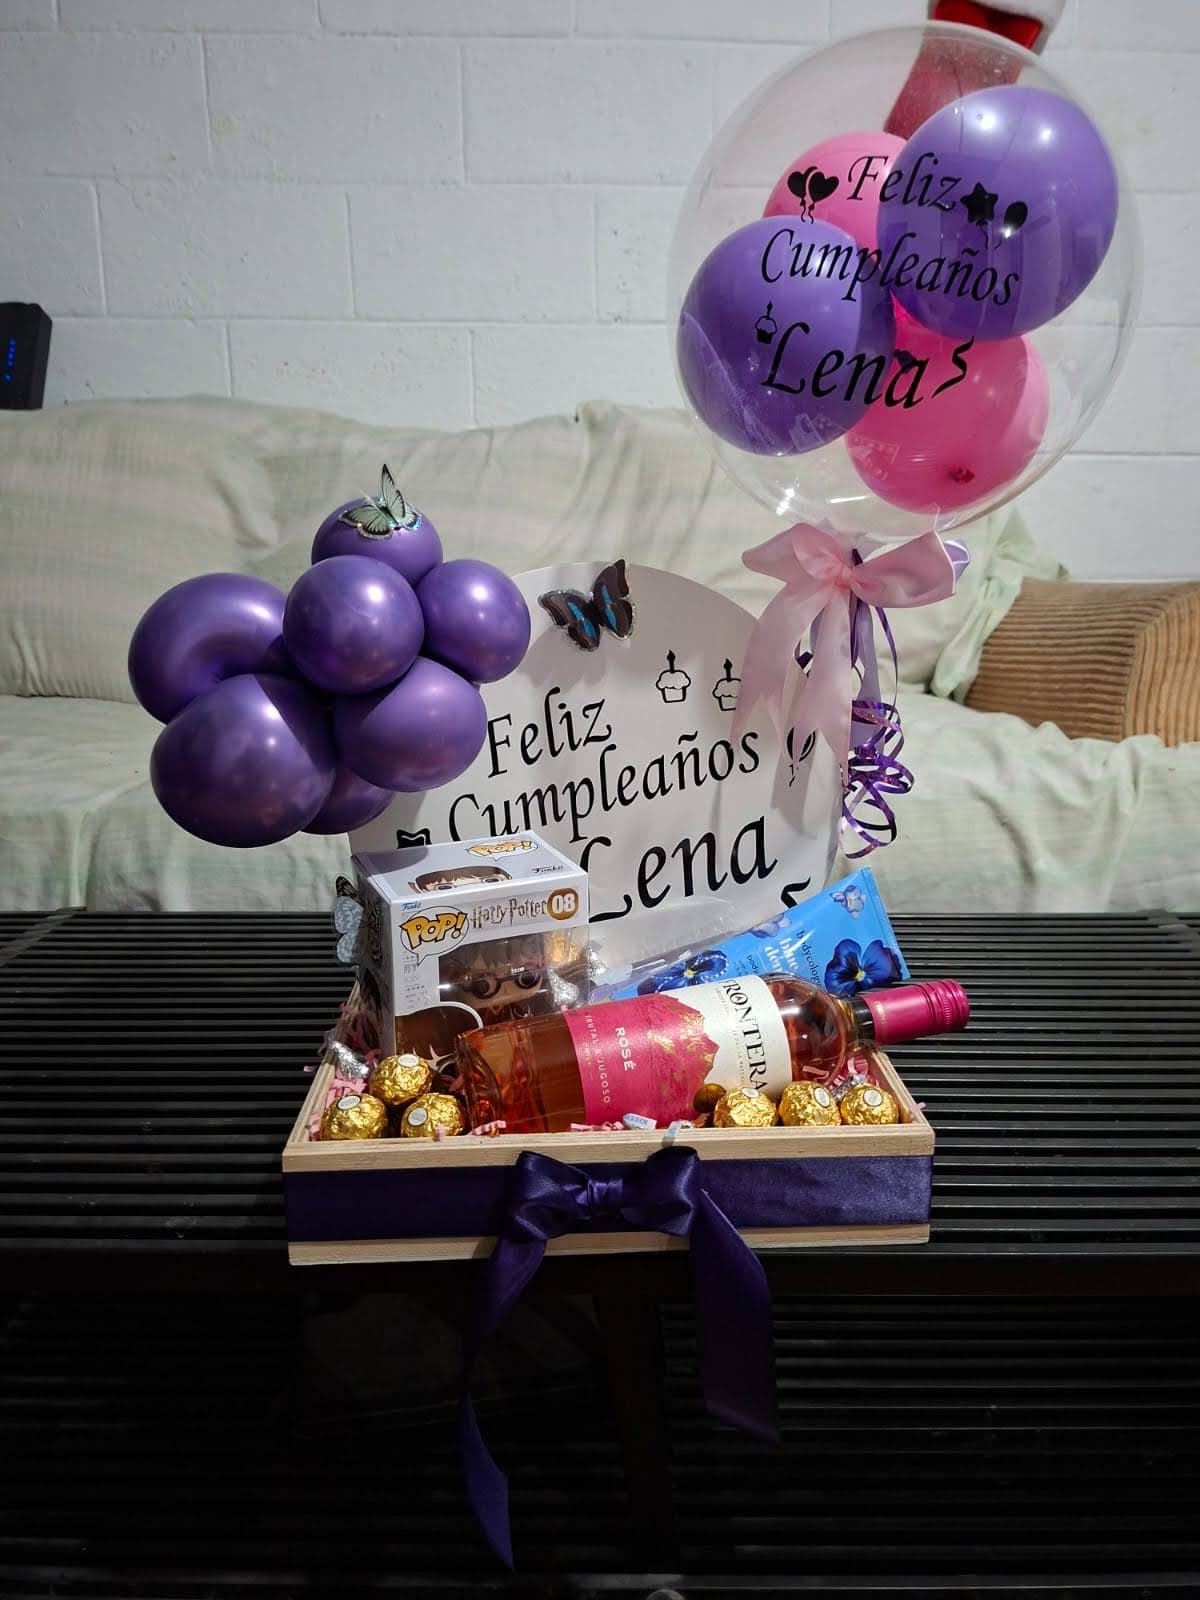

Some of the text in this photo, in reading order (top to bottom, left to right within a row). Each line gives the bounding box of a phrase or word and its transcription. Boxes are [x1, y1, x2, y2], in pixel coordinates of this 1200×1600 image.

[847, 151, 962, 212] Feliz
[761, 228, 1020, 306] Cumpleaños
[761, 321, 930, 409] Lena
[487, 687, 612, 778] Feliz
[449, 730, 760, 843] Cumpleaños
[579, 815, 778, 924] Lena
[399, 912, 468, 950] POP!
[470, 892, 576, 929] Harry Potter 08
[597, 1057, 611, 1103] JUGOSO
[615, 1026, 637, 1071] ROSÉ
